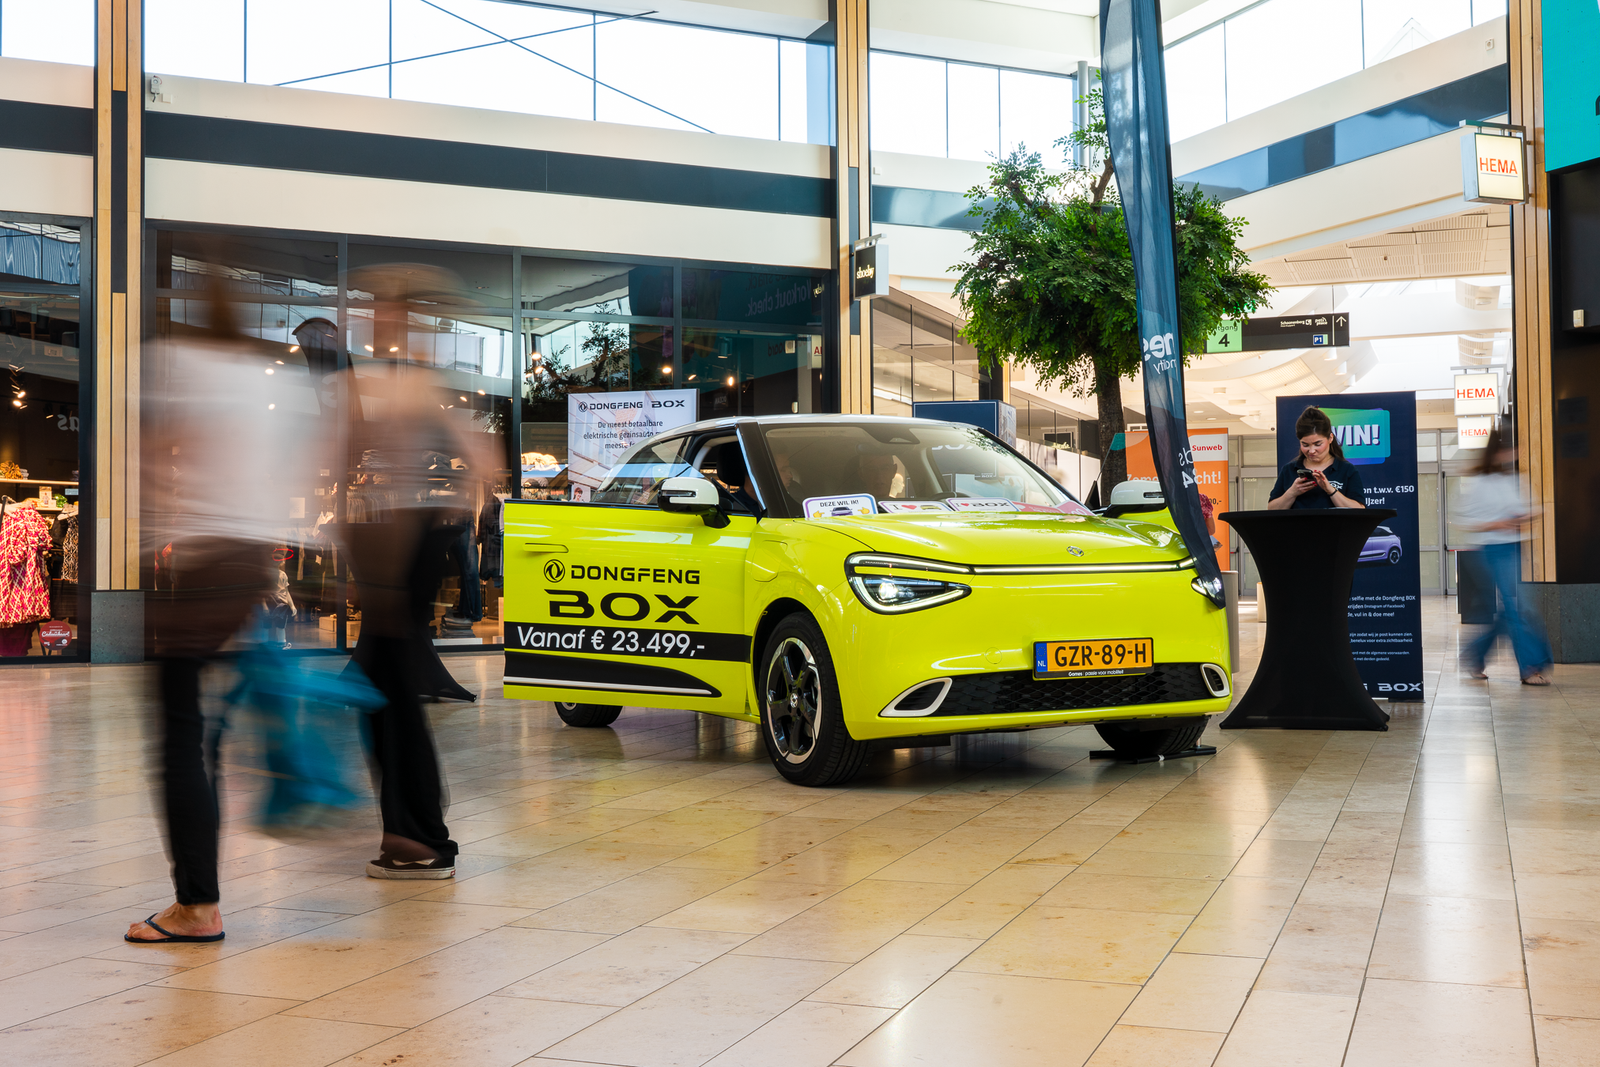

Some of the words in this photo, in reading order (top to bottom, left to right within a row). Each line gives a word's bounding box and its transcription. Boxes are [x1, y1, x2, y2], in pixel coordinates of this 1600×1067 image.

[1479, 156, 1518, 175] HEMA
[856, 264, 875, 280] shoeby
[1216, 324, 1238, 332] tgang
[1218, 333, 1230, 348] 4
[1456, 387, 1496, 399] HEMA
[589, 401, 643, 410] DONGFENG
[651, 400, 686, 408] BOX
[628, 420, 664, 428] betaalbare
[619, 432, 654, 440] gezinsauto
[1460, 428, 1488, 437] HEMA
[1395, 485, 1414, 494] €150
[571, 564, 700, 585] DONGFENG
[544, 588, 700, 625] BOX
[517, 625, 584, 649] Vanaf
[590, 630, 606, 650] €
[612, 630, 706, 658] 23.499,-
[1054, 642, 1146, 668] GZR-89-H
[1377, 682, 1422, 692] BOX
